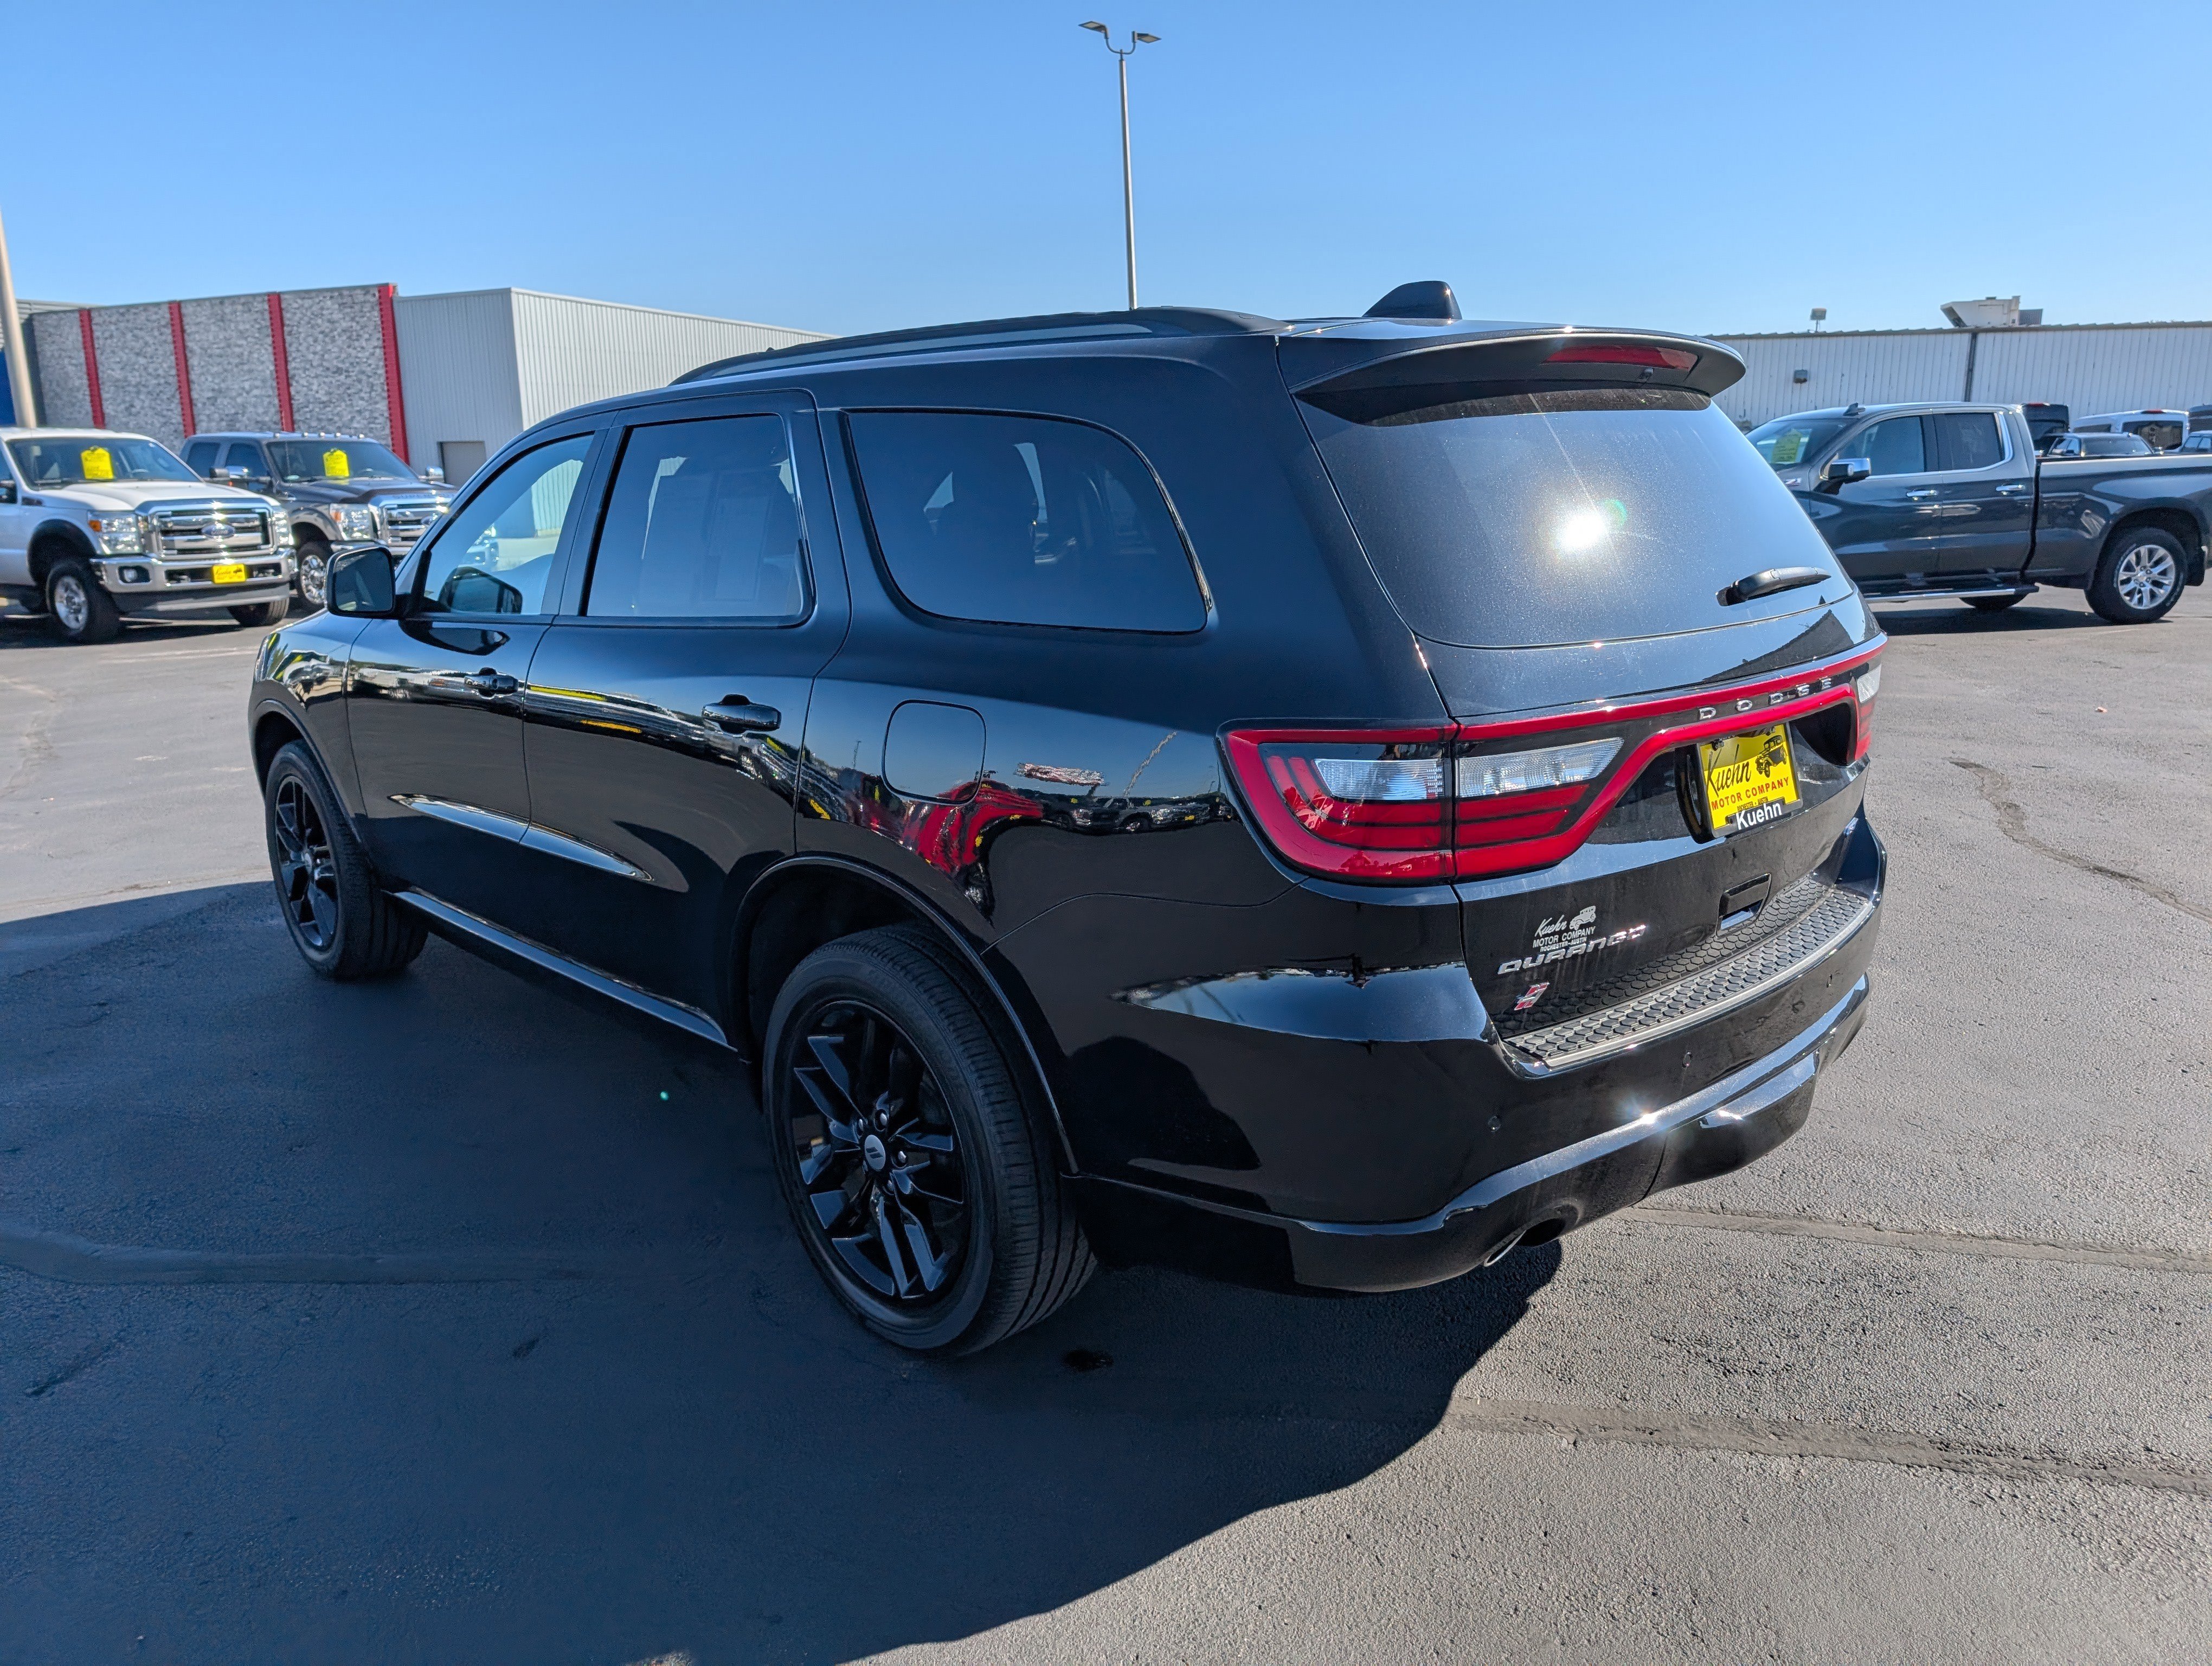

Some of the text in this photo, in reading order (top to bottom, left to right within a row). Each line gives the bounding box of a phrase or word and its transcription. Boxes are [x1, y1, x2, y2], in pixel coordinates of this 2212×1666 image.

[1697, 678, 1832, 720] DODGE
[1706, 744, 1752, 798] Kuehn
[1711, 776, 1789, 811] MOTOR COMPANY
[1735, 803, 1782, 830] Kuehn
[1533, 926, 1596, 949] MOTOR COMPANY
[1535, 914, 1567, 937] Kuehn
[1497, 924, 1647, 975] DURANGO
